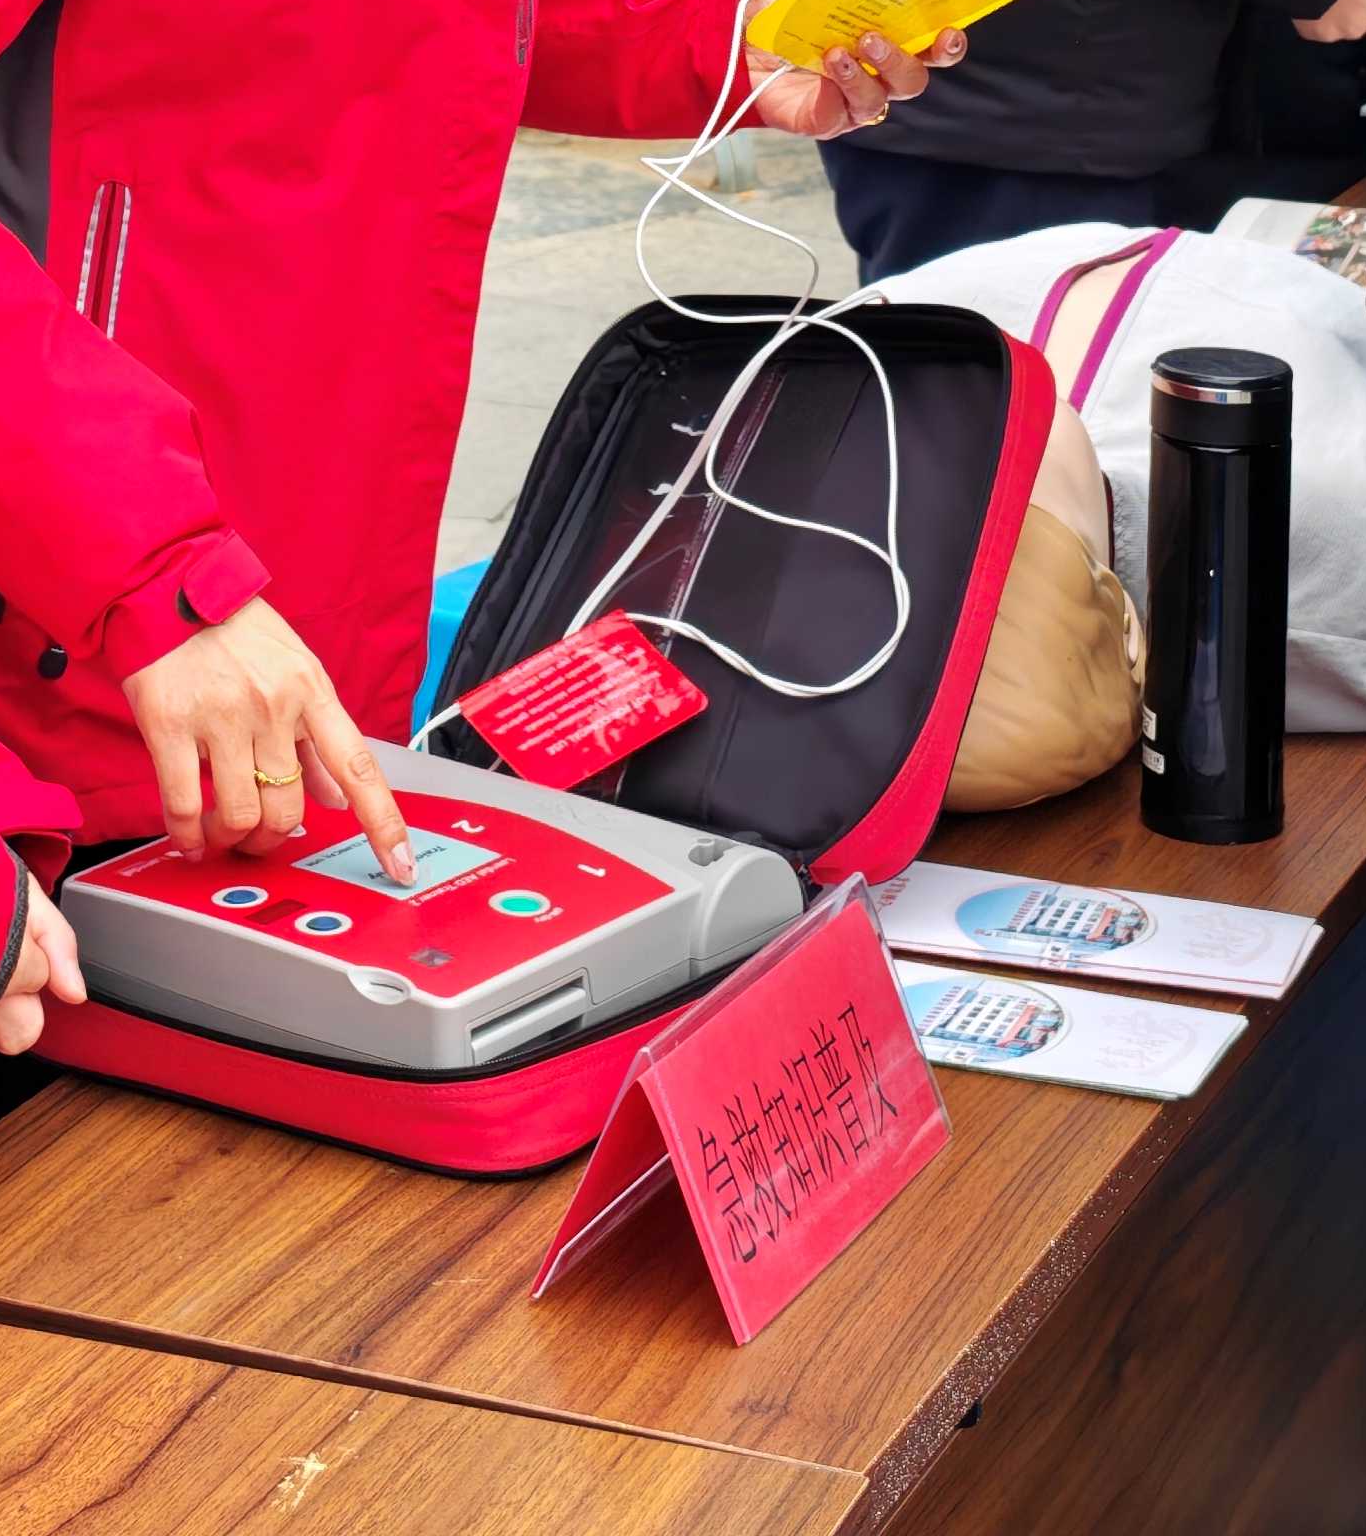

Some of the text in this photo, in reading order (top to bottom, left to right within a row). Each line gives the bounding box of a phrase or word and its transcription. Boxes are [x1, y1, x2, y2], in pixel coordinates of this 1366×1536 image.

[697, 1002, 898, 1264] 急救知识普及
